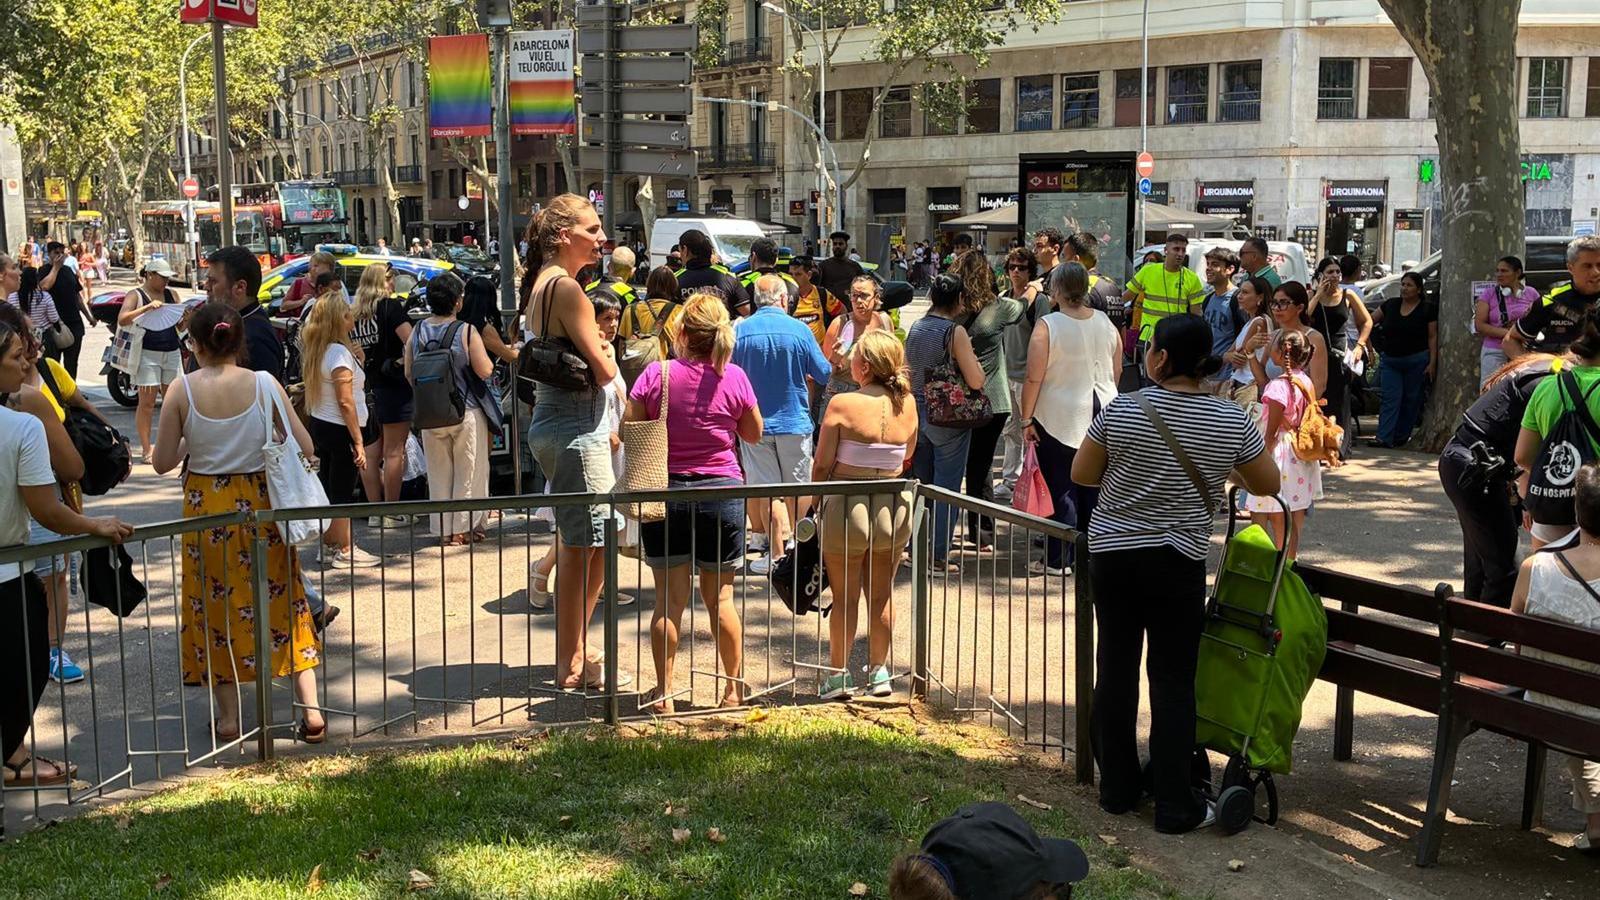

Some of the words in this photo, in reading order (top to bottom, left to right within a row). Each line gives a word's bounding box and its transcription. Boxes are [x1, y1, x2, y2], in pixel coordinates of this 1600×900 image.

[513, 41, 519, 52] A
[520, 40, 570, 51] BARCELONA
[529, 51, 544, 62] VIU
[545, 51, 555, 61] EL
[518, 62, 532, 73] TEU
[534, 61, 567, 72] ORGULL
[1046, 176, 1059, 186] L1
[666, 189, 686, 199] EXCHANGE
[1203, 187, 1254, 197] URQUINAONA
[1330, 187, 1385, 197] URQUINAONA
[1542, 486, 1577, 498] HOSPITA
